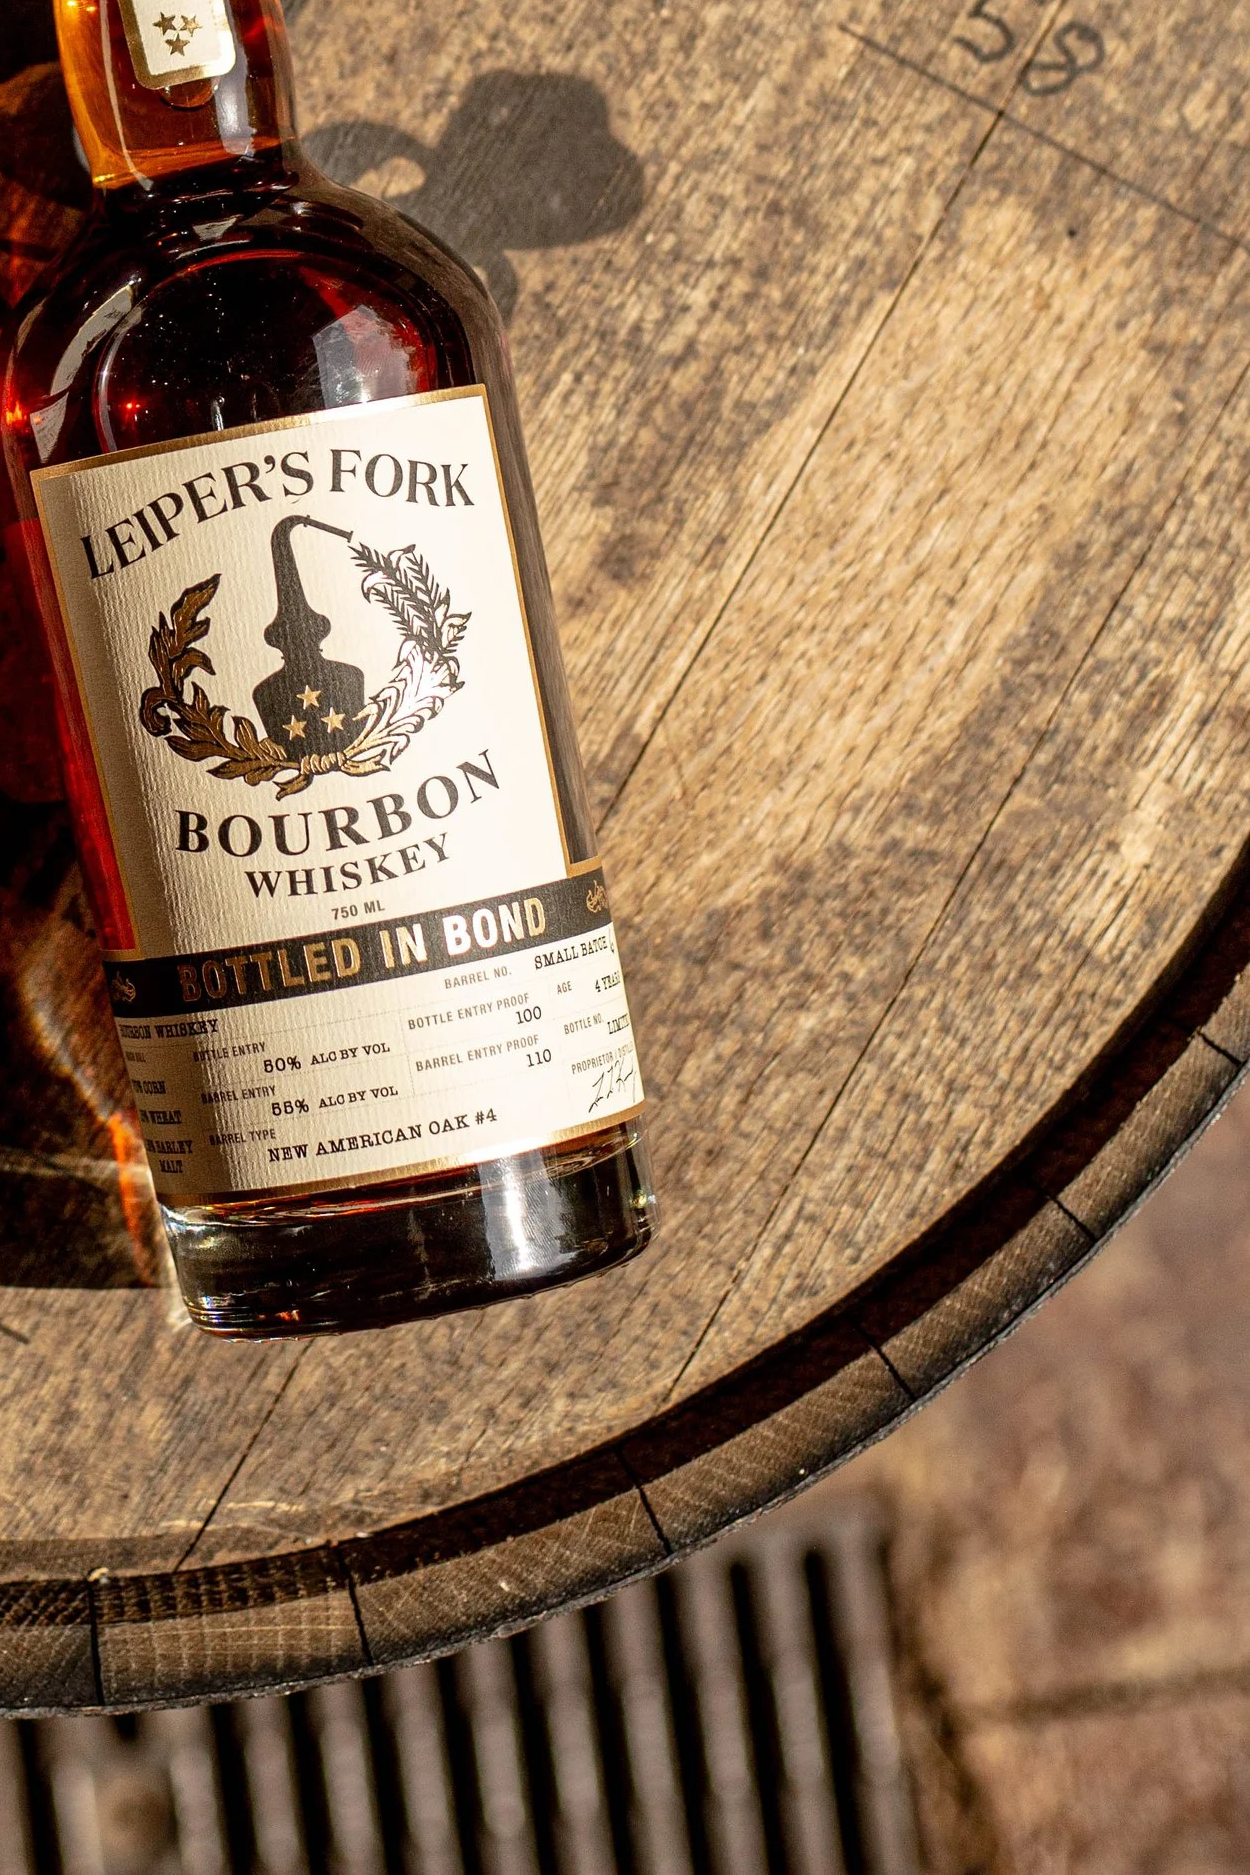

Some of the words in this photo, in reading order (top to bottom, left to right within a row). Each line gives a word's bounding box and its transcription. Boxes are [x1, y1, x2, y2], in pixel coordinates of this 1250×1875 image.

[80, 450, 314, 580] LEIPER'S
[328, 448, 476, 509] FORK
[174, 749, 501, 857] BOURBON
[244, 831, 452, 899] WHISKEY
[331, 905, 359, 921] 750
[360, 899, 387, 915] ML
[177, 936, 362, 1002] BOTTLED
[378, 924, 429, 969] IN
[442, 896, 548, 957] BOND
[534, 945, 579, 970] SMALL
[444, 971, 489, 990] BARREL
[494, 965, 513, 979] NO.
[557, 980, 573, 995] AGE
[408, 1011, 454, 1030] BOTTLE
[457, 1002, 493, 1022] ENTRY
[496, 992, 530, 1011] PROOF
[516, 1005, 542, 1025] 100
[154, 1018, 219, 1038] WHISKEY
[564, 1016, 592, 1035] BOTTLE
[192, 1045, 230, 1063] BOTTLE
[232, 1041, 266, 1058] ENTRY
[263, 1056, 302, 1074] 50%
[310, 1050, 337, 1066] ALC
[339, 1047, 359, 1061] BY
[362, 1042, 391, 1056] VOL
[416, 1053, 464, 1072] BARREL
[467, 1044, 503, 1062] ENTRY
[506, 1035, 540, 1053] PROOF
[526, 1048, 552, 1067] 110
[571, 1051, 614, 1075] PROPRIETOR
[201, 1088, 239, 1104] BARREL
[242, 1085, 277, 1100] ENTRY
[271, 1099, 310, 1117] 55%
[318, 1094, 345, 1110] ALC
[346, 1090, 366, 1104] BY
[370, 1085, 399, 1100] VOL
[209, 1131, 246, 1146] BARREL
[249, 1128, 277, 1143] TYPE
[268, 1143, 309, 1163] NEW
[315, 1123, 423, 1157] AMERICAN
[428, 1113, 470, 1135] OAK
[474, 1107, 498, 1125] #4
